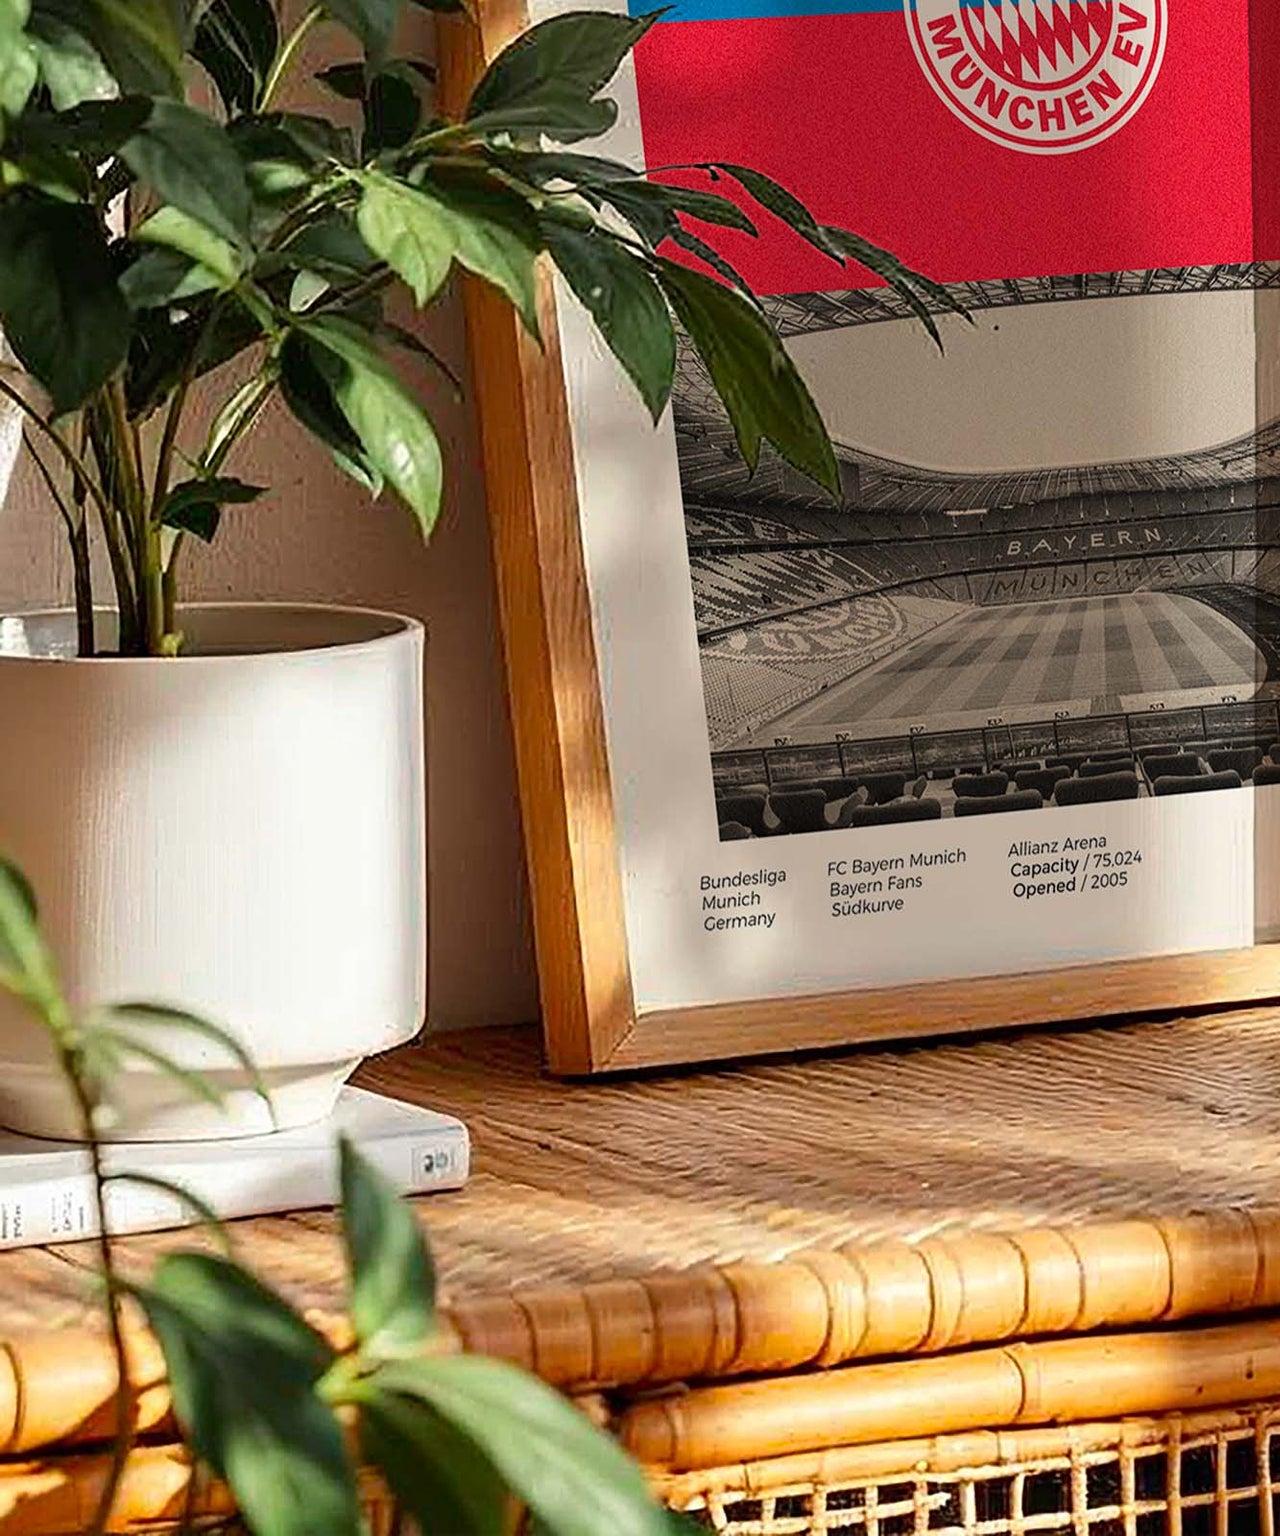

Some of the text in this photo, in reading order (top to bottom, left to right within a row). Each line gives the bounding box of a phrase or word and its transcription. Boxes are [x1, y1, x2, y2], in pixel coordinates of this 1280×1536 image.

[926, 2, 1148, 132] MÜNCHEN EV
[1007, 527, 1161, 556] BAYERN
[995, 561, 1206, 595] MÜNCHEN
[1007, 836, 1107, 858] Allianz Arena
[827, 849, 968, 877] FC Bayern Munich
[1010, 857, 1080, 879] Capacity
[700, 869, 787, 892] Bundesliga
[829, 875, 923, 899] Bayern Fans
[1012, 877, 1077, 900] Opened
[1090, 870, 1128, 890] 2005
[702, 892, 761, 911] Munich
[832, 899, 904, 917] Südkurve
[704, 913, 776, 931] Germany
